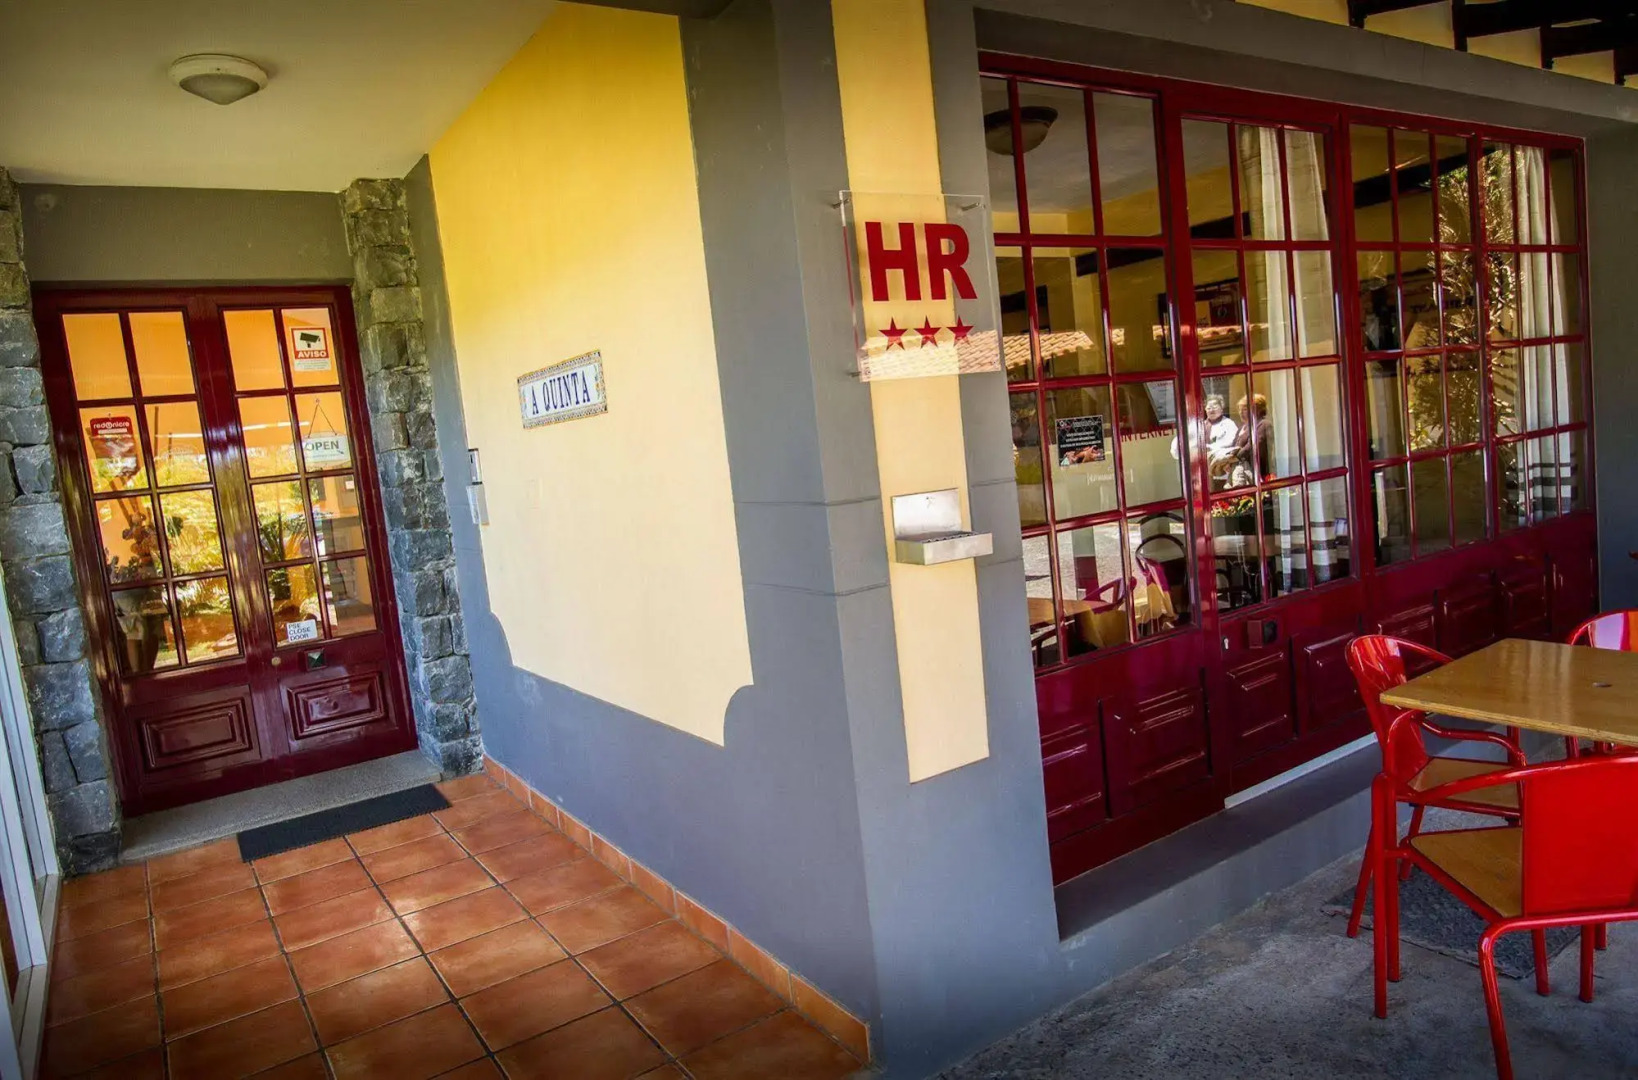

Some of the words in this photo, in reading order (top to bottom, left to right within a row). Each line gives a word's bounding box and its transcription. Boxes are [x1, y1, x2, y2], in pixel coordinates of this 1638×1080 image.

[864, 221, 977, 302] HR
[298, 350, 327, 358] AVISO
[532, 386, 539, 414] A
[542, 370, 590, 411] QUINTA
[1121, 424, 1175, 443] INTERNET
[305, 440, 340, 451] OPEN
[289, 627, 310, 635] CLOSE
[290, 633, 308, 641] DOOR
